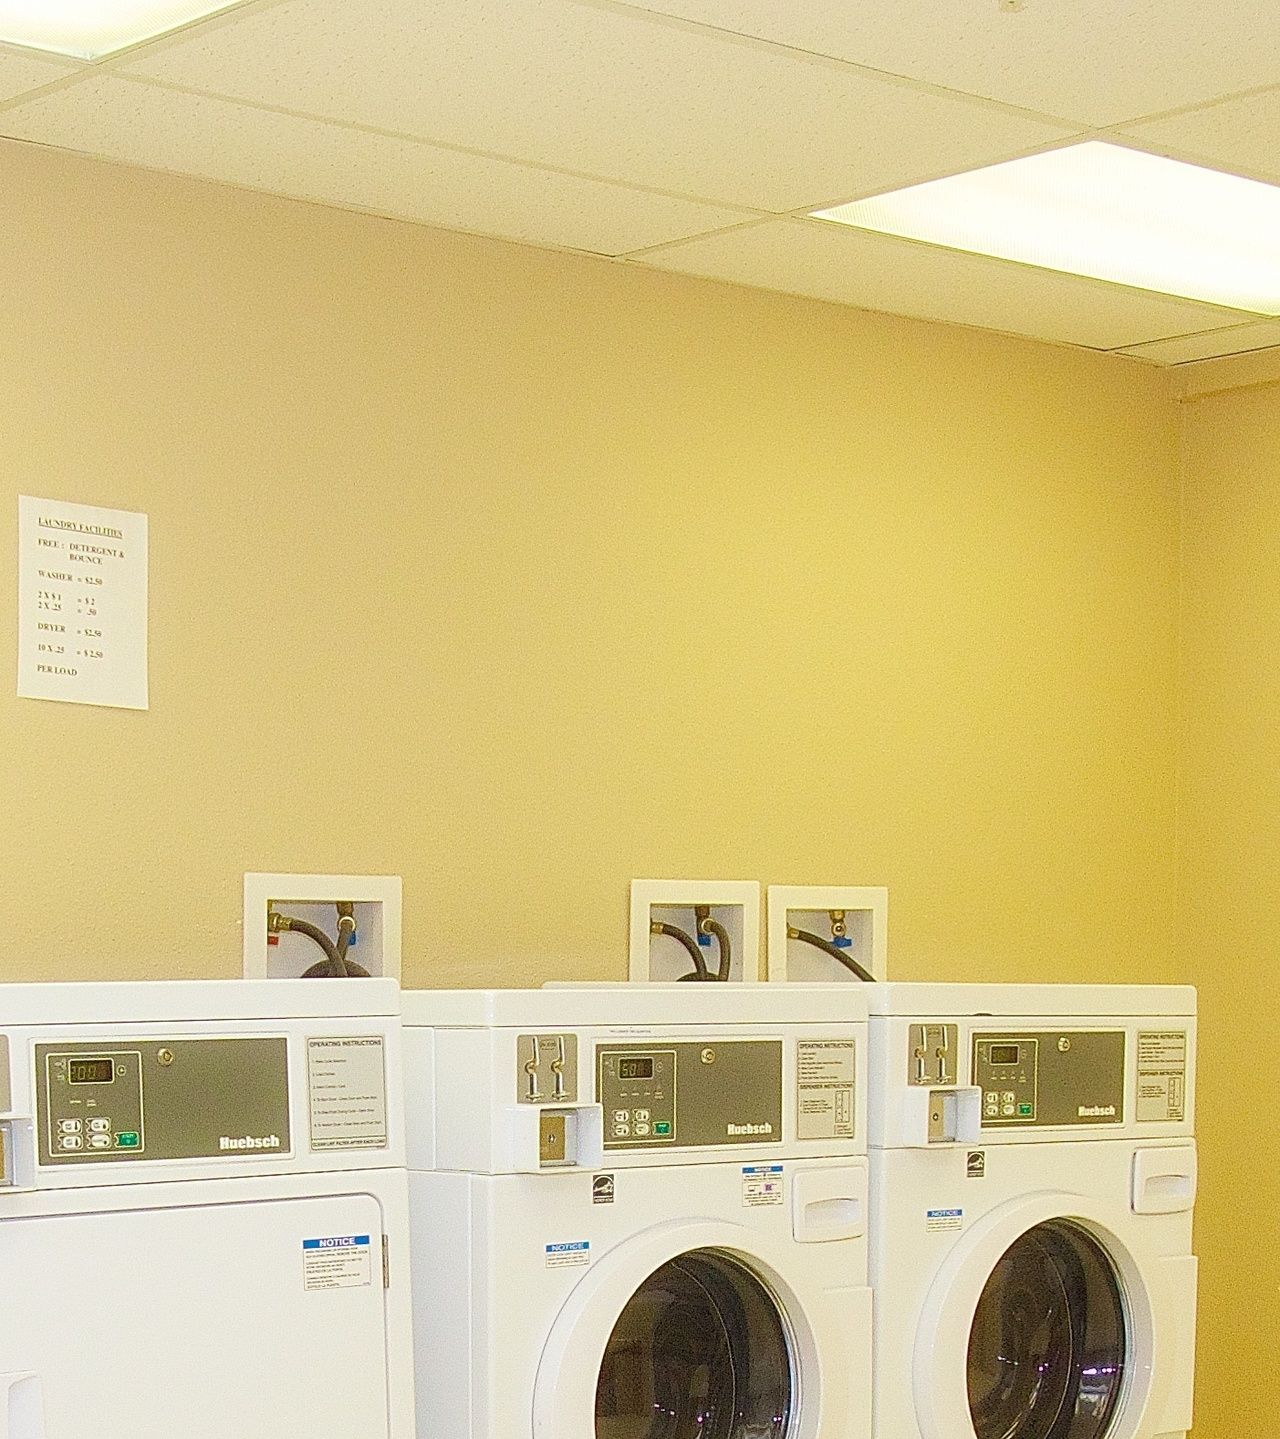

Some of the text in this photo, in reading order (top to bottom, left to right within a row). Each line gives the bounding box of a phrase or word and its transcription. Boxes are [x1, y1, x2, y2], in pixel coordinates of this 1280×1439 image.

[38, 517, 123, 537] LAUNDRY FACILITIES
[38, 539, 59, 548] FREE
[70, 544, 117, 558] DETERGENT
[70, 554, 103, 565] BOUNCE
[38, 570, 73, 582] WASHER
[38, 623, 66, 632] DRYER
[38, 664, 78, 676] PER LOAD
[1078, 1104, 1116, 1117] Huebsch
[728, 1122, 772, 1136] Huebsch
[219, 1134, 280, 1150] Huebsch
[931, 1210, 958, 1218] NOTICE
[319, 1237, 356, 1247] NOTICE
[552, 1243, 584, 1251] NOTICE
